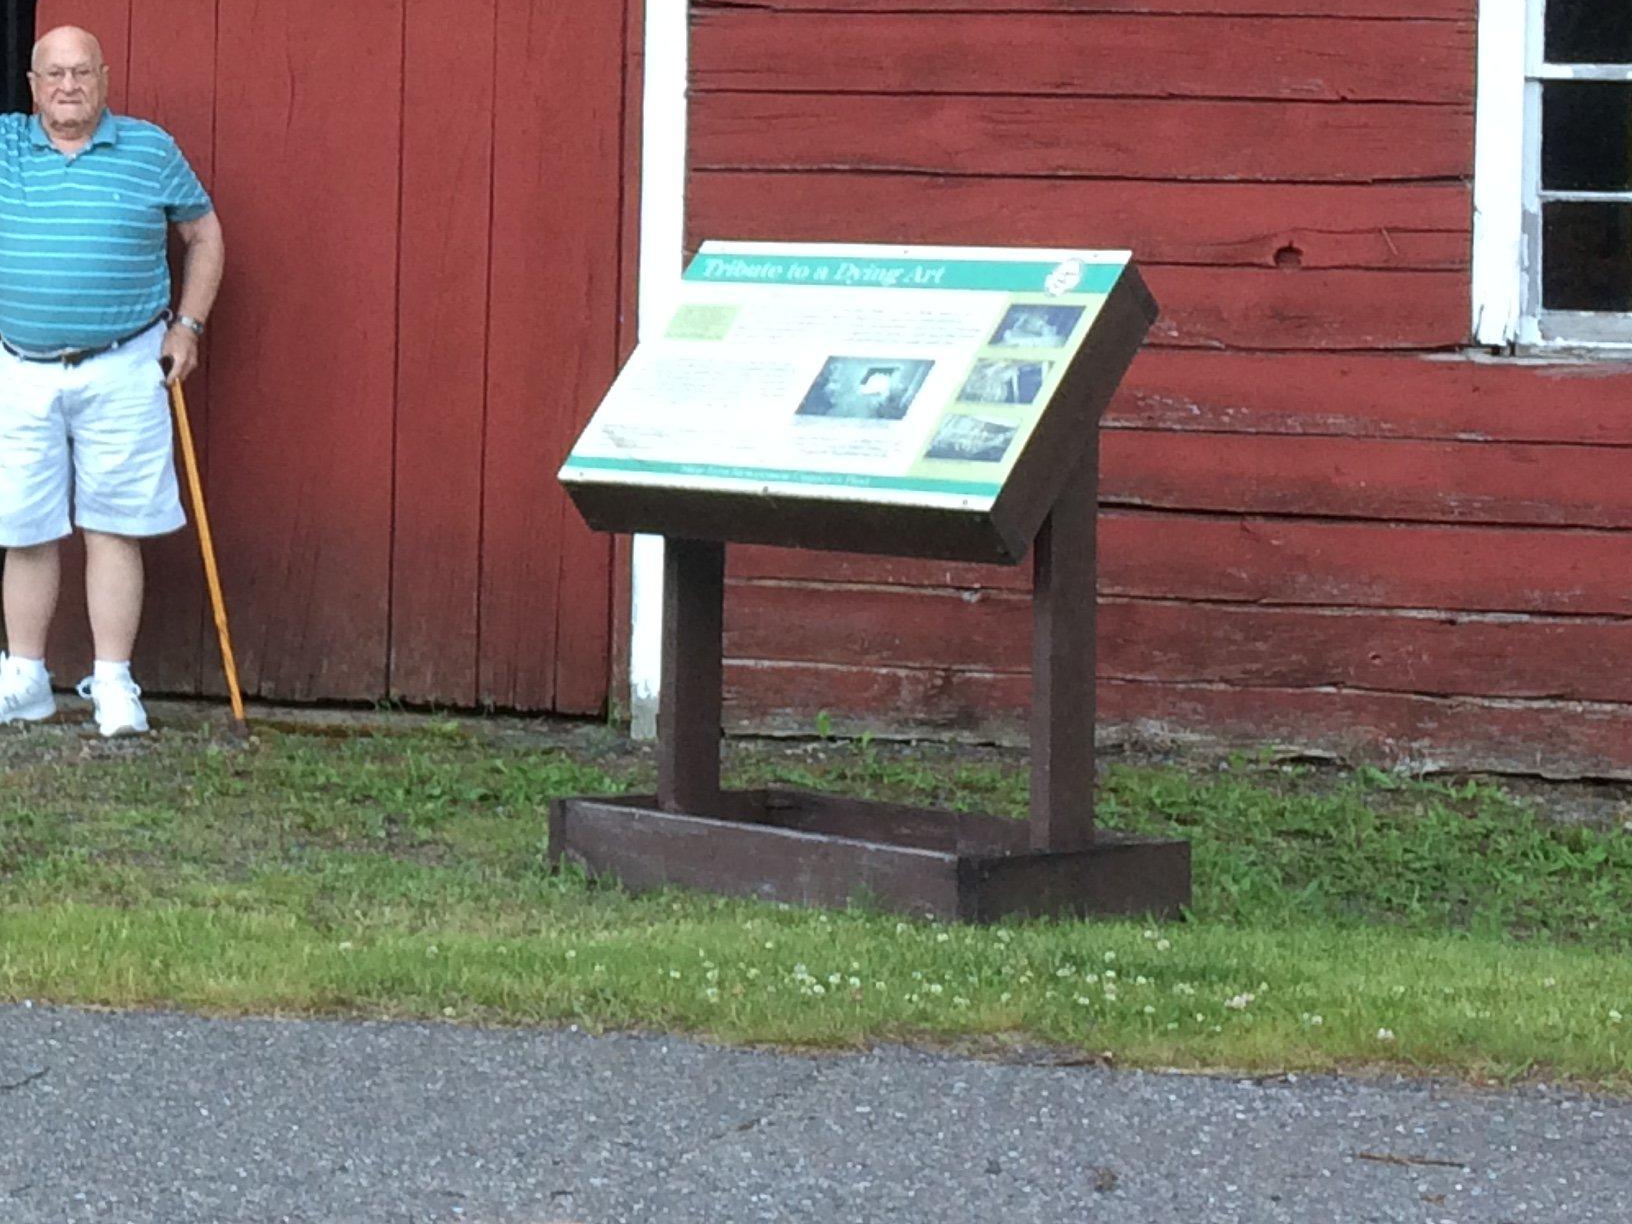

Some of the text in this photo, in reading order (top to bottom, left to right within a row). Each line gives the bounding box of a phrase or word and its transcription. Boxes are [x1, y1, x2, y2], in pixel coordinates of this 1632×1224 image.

[704, 257, 946, 287] Tribute to a Dying Art
